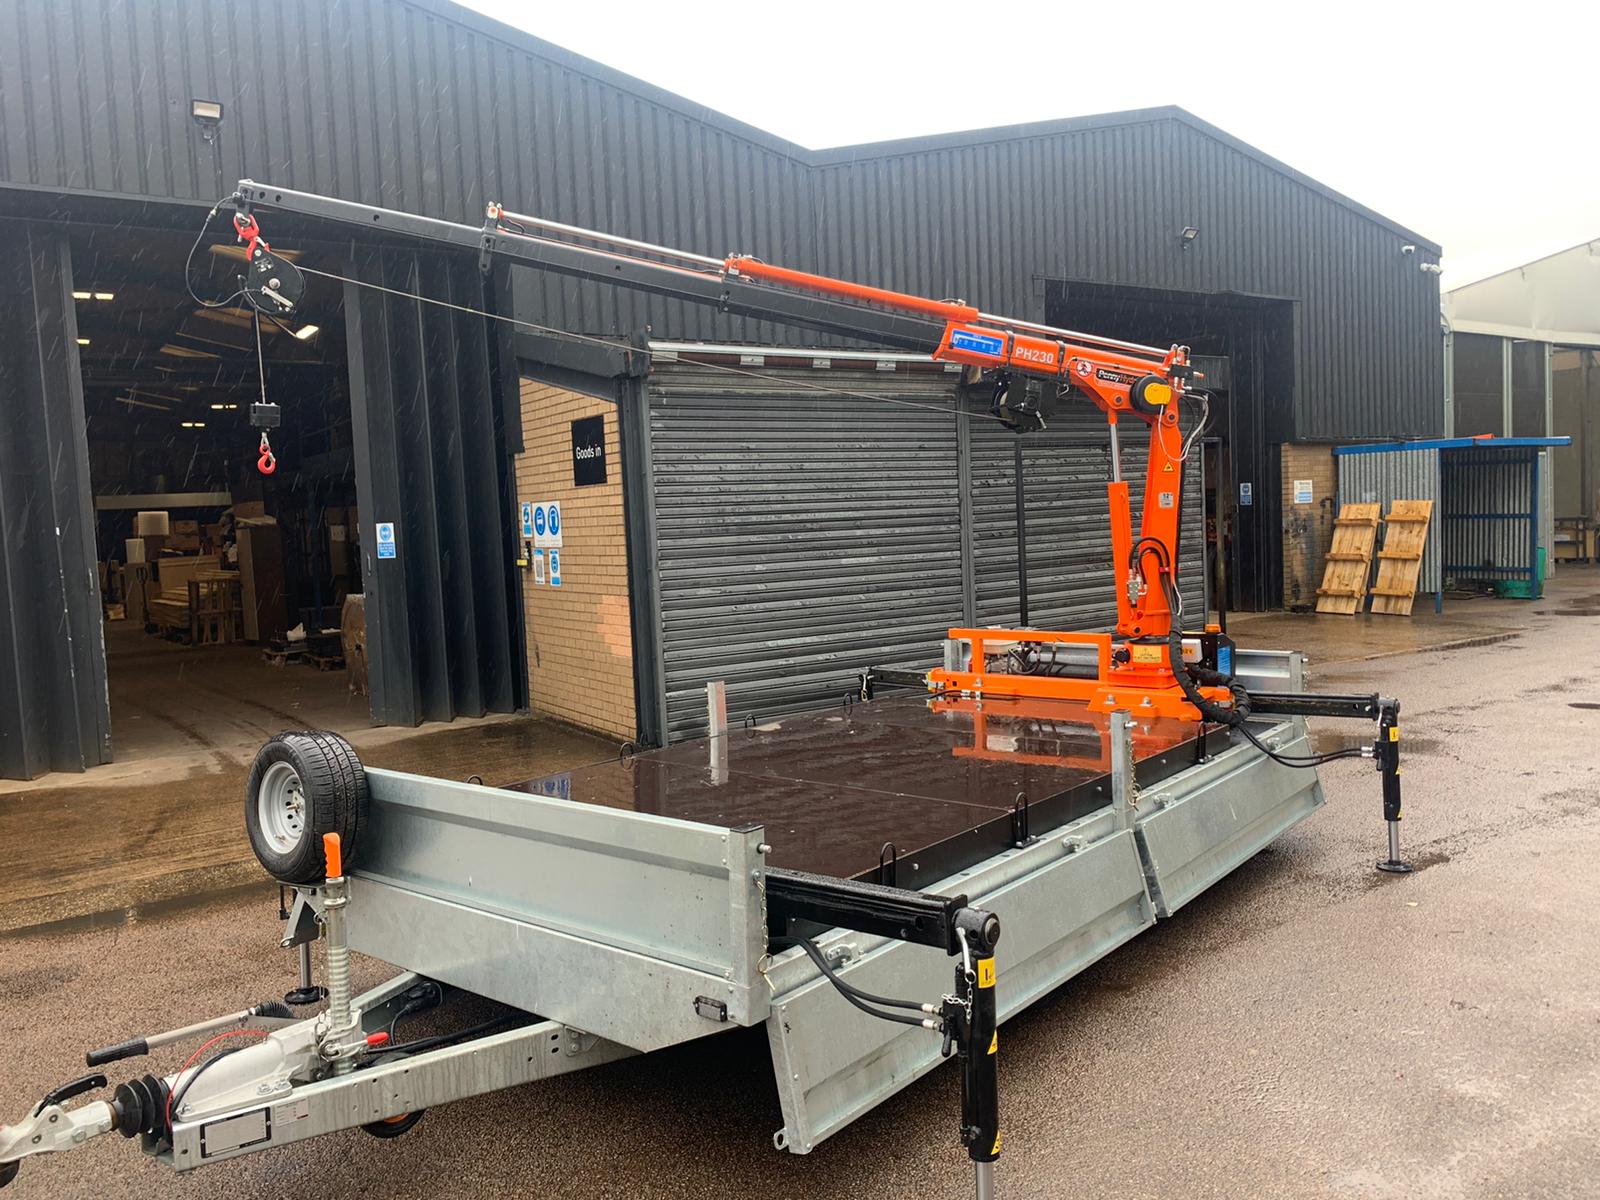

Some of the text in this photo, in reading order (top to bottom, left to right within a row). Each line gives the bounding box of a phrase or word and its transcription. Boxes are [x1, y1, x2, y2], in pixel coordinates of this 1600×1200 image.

[1015, 346, 1054, 364] PH230
[576, 443, 602, 460] Goods in
